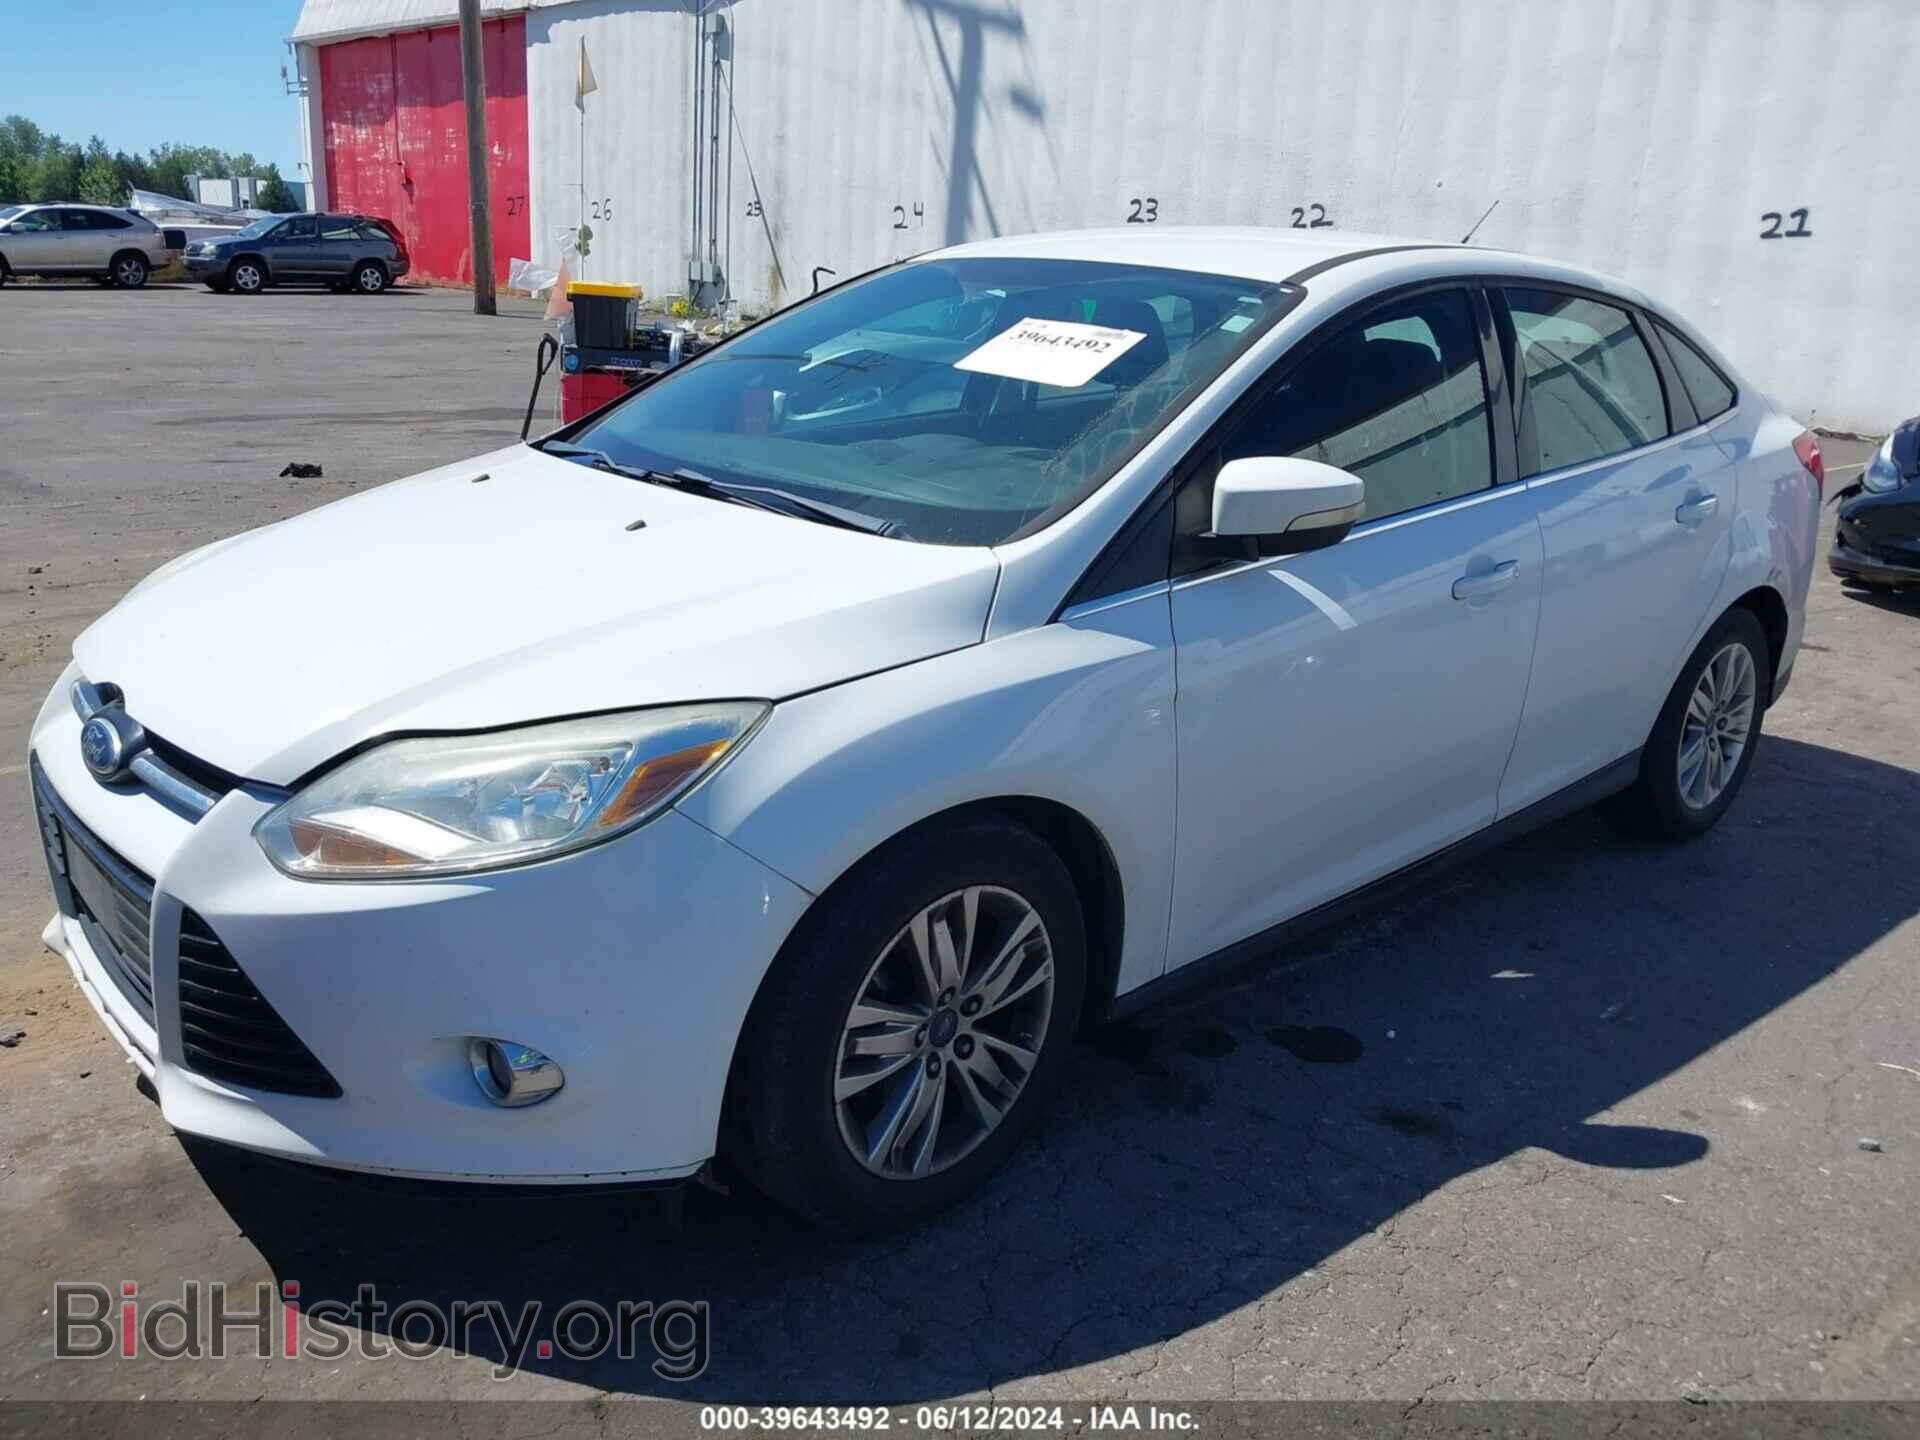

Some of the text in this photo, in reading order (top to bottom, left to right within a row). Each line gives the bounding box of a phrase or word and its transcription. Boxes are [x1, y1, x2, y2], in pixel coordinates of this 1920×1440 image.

[507, 196, 525, 216] 27
[591, 198, 612, 221] 26
[893, 202, 924, 230] 24
[1126, 198, 1159, 223] 23
[1291, 204, 1333, 229] 22
[1760, 208, 1812, 239] 21
